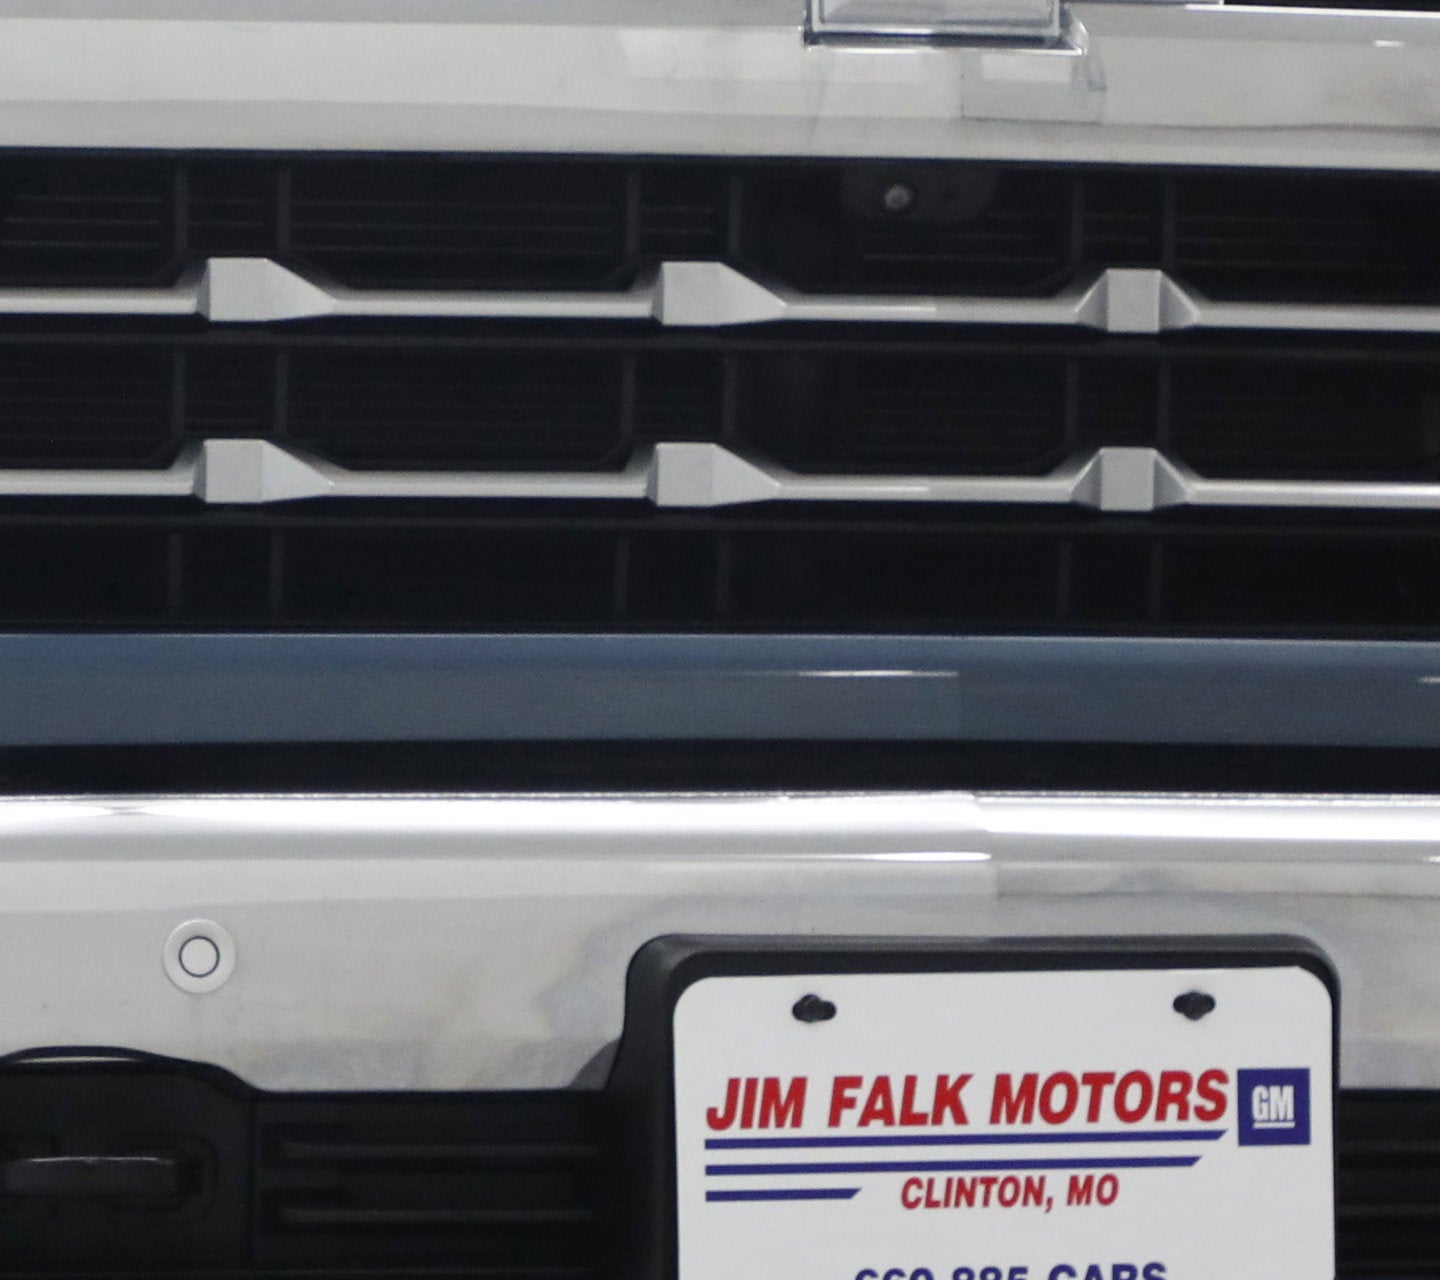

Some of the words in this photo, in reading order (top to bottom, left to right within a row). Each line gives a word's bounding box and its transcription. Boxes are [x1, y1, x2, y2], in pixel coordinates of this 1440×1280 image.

[706, 1076, 808, 1131] JIM
[828, 1073, 973, 1128] FALK
[990, 1068, 1229, 1126] MOTORS
[1251, 1085, 1295, 1121] GM
[900, 1175, 1053, 1213] CLINTON,
[1067, 1174, 1119, 1207] MO
